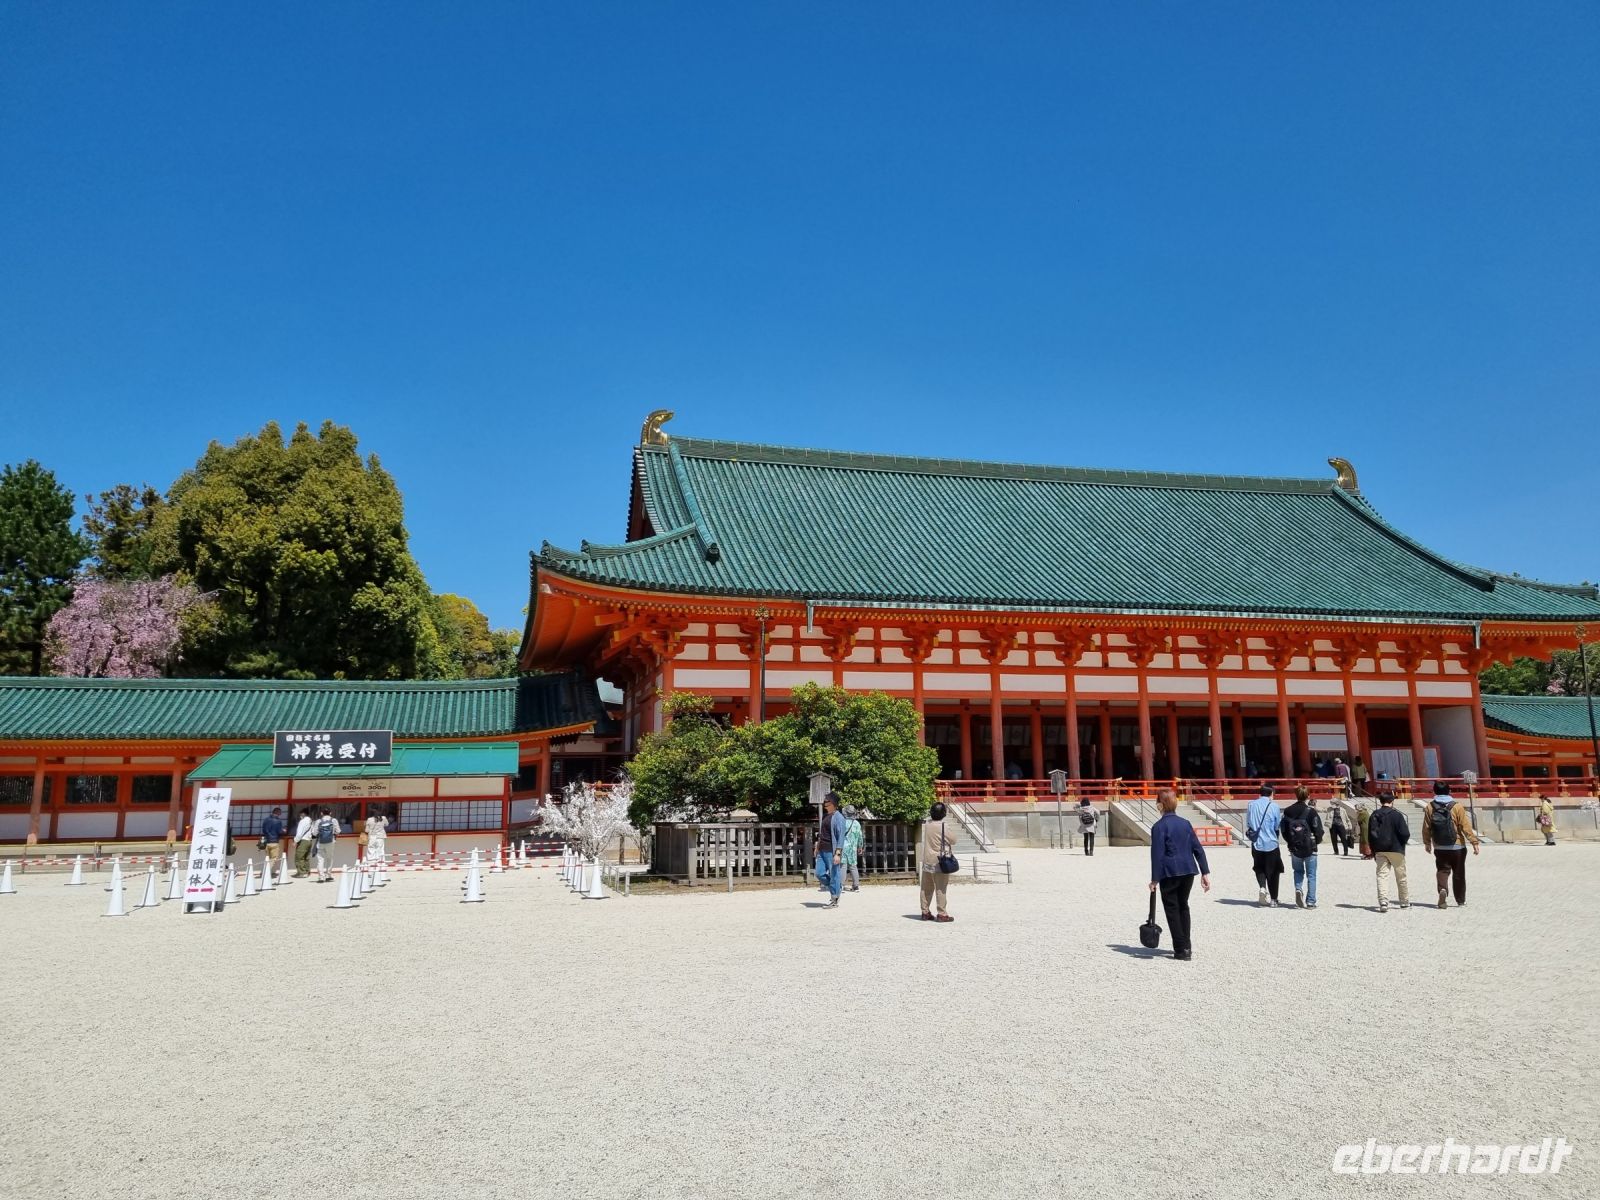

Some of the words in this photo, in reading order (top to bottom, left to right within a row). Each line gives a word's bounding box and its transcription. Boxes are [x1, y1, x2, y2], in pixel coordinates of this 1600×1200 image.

[291, 742, 378, 760] 神苑受付
[196, 792, 225, 855] 神苑受付
